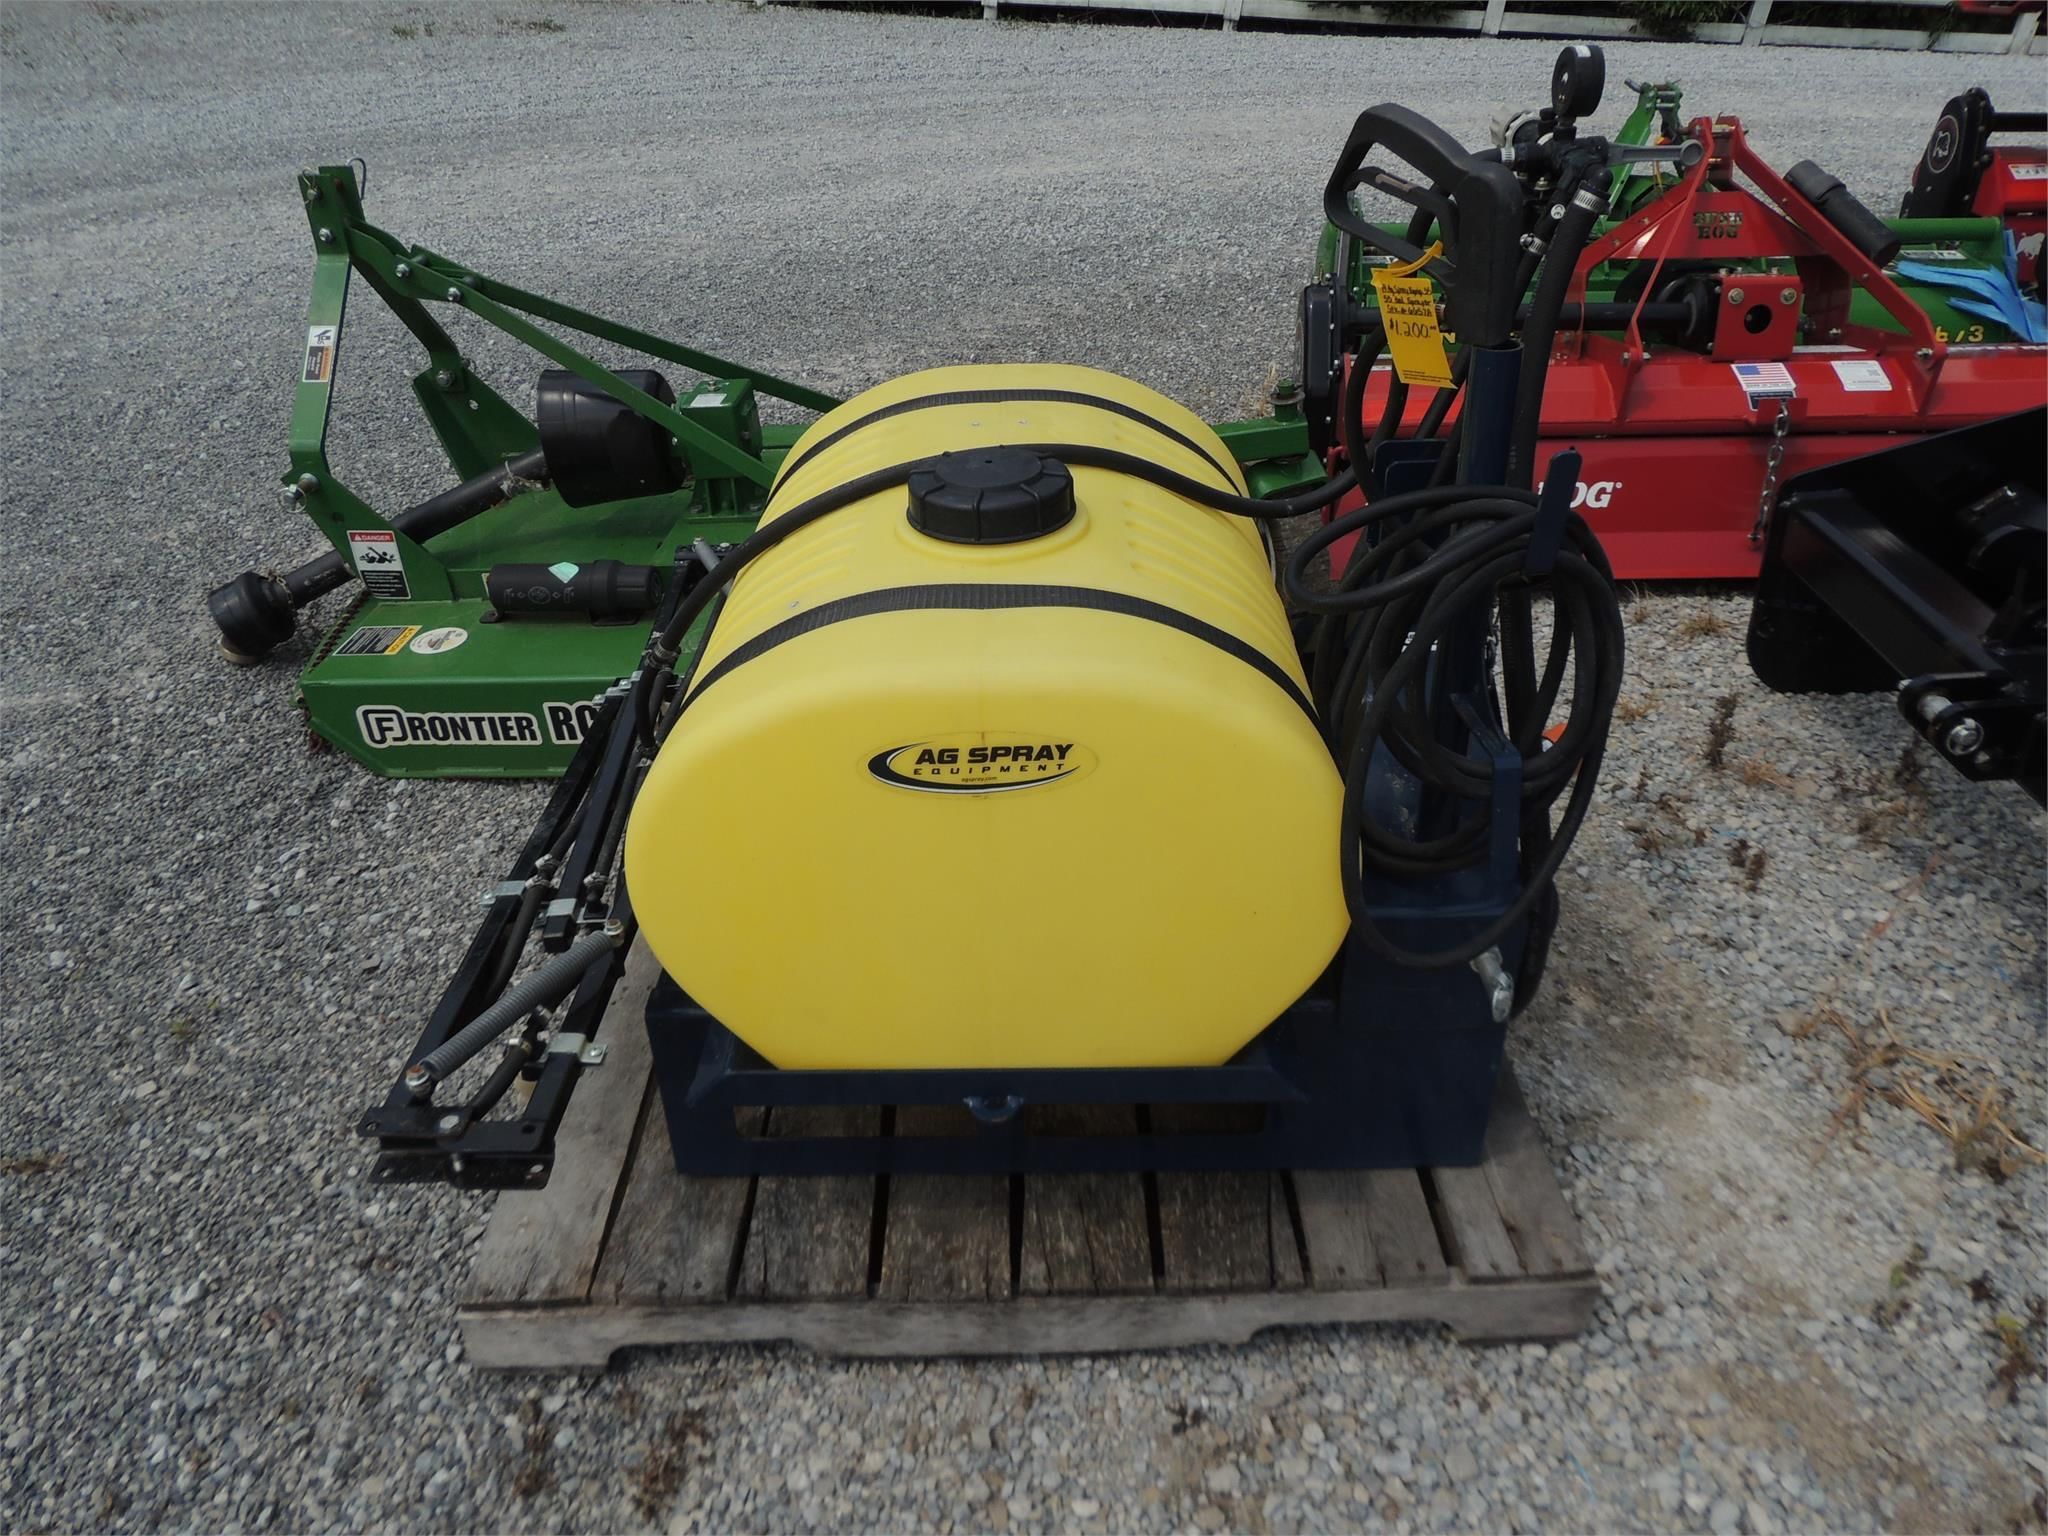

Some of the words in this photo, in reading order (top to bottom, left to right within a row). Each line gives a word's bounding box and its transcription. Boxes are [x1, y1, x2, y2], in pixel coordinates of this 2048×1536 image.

[1697, 225, 1738, 239] HOG
[361, 709, 538, 745] FRONTIER
[915, 748, 960, 765] AG
[967, 743, 1074, 764] SPRAY
[914, 764, 1065, 776] EQUIPMENT
